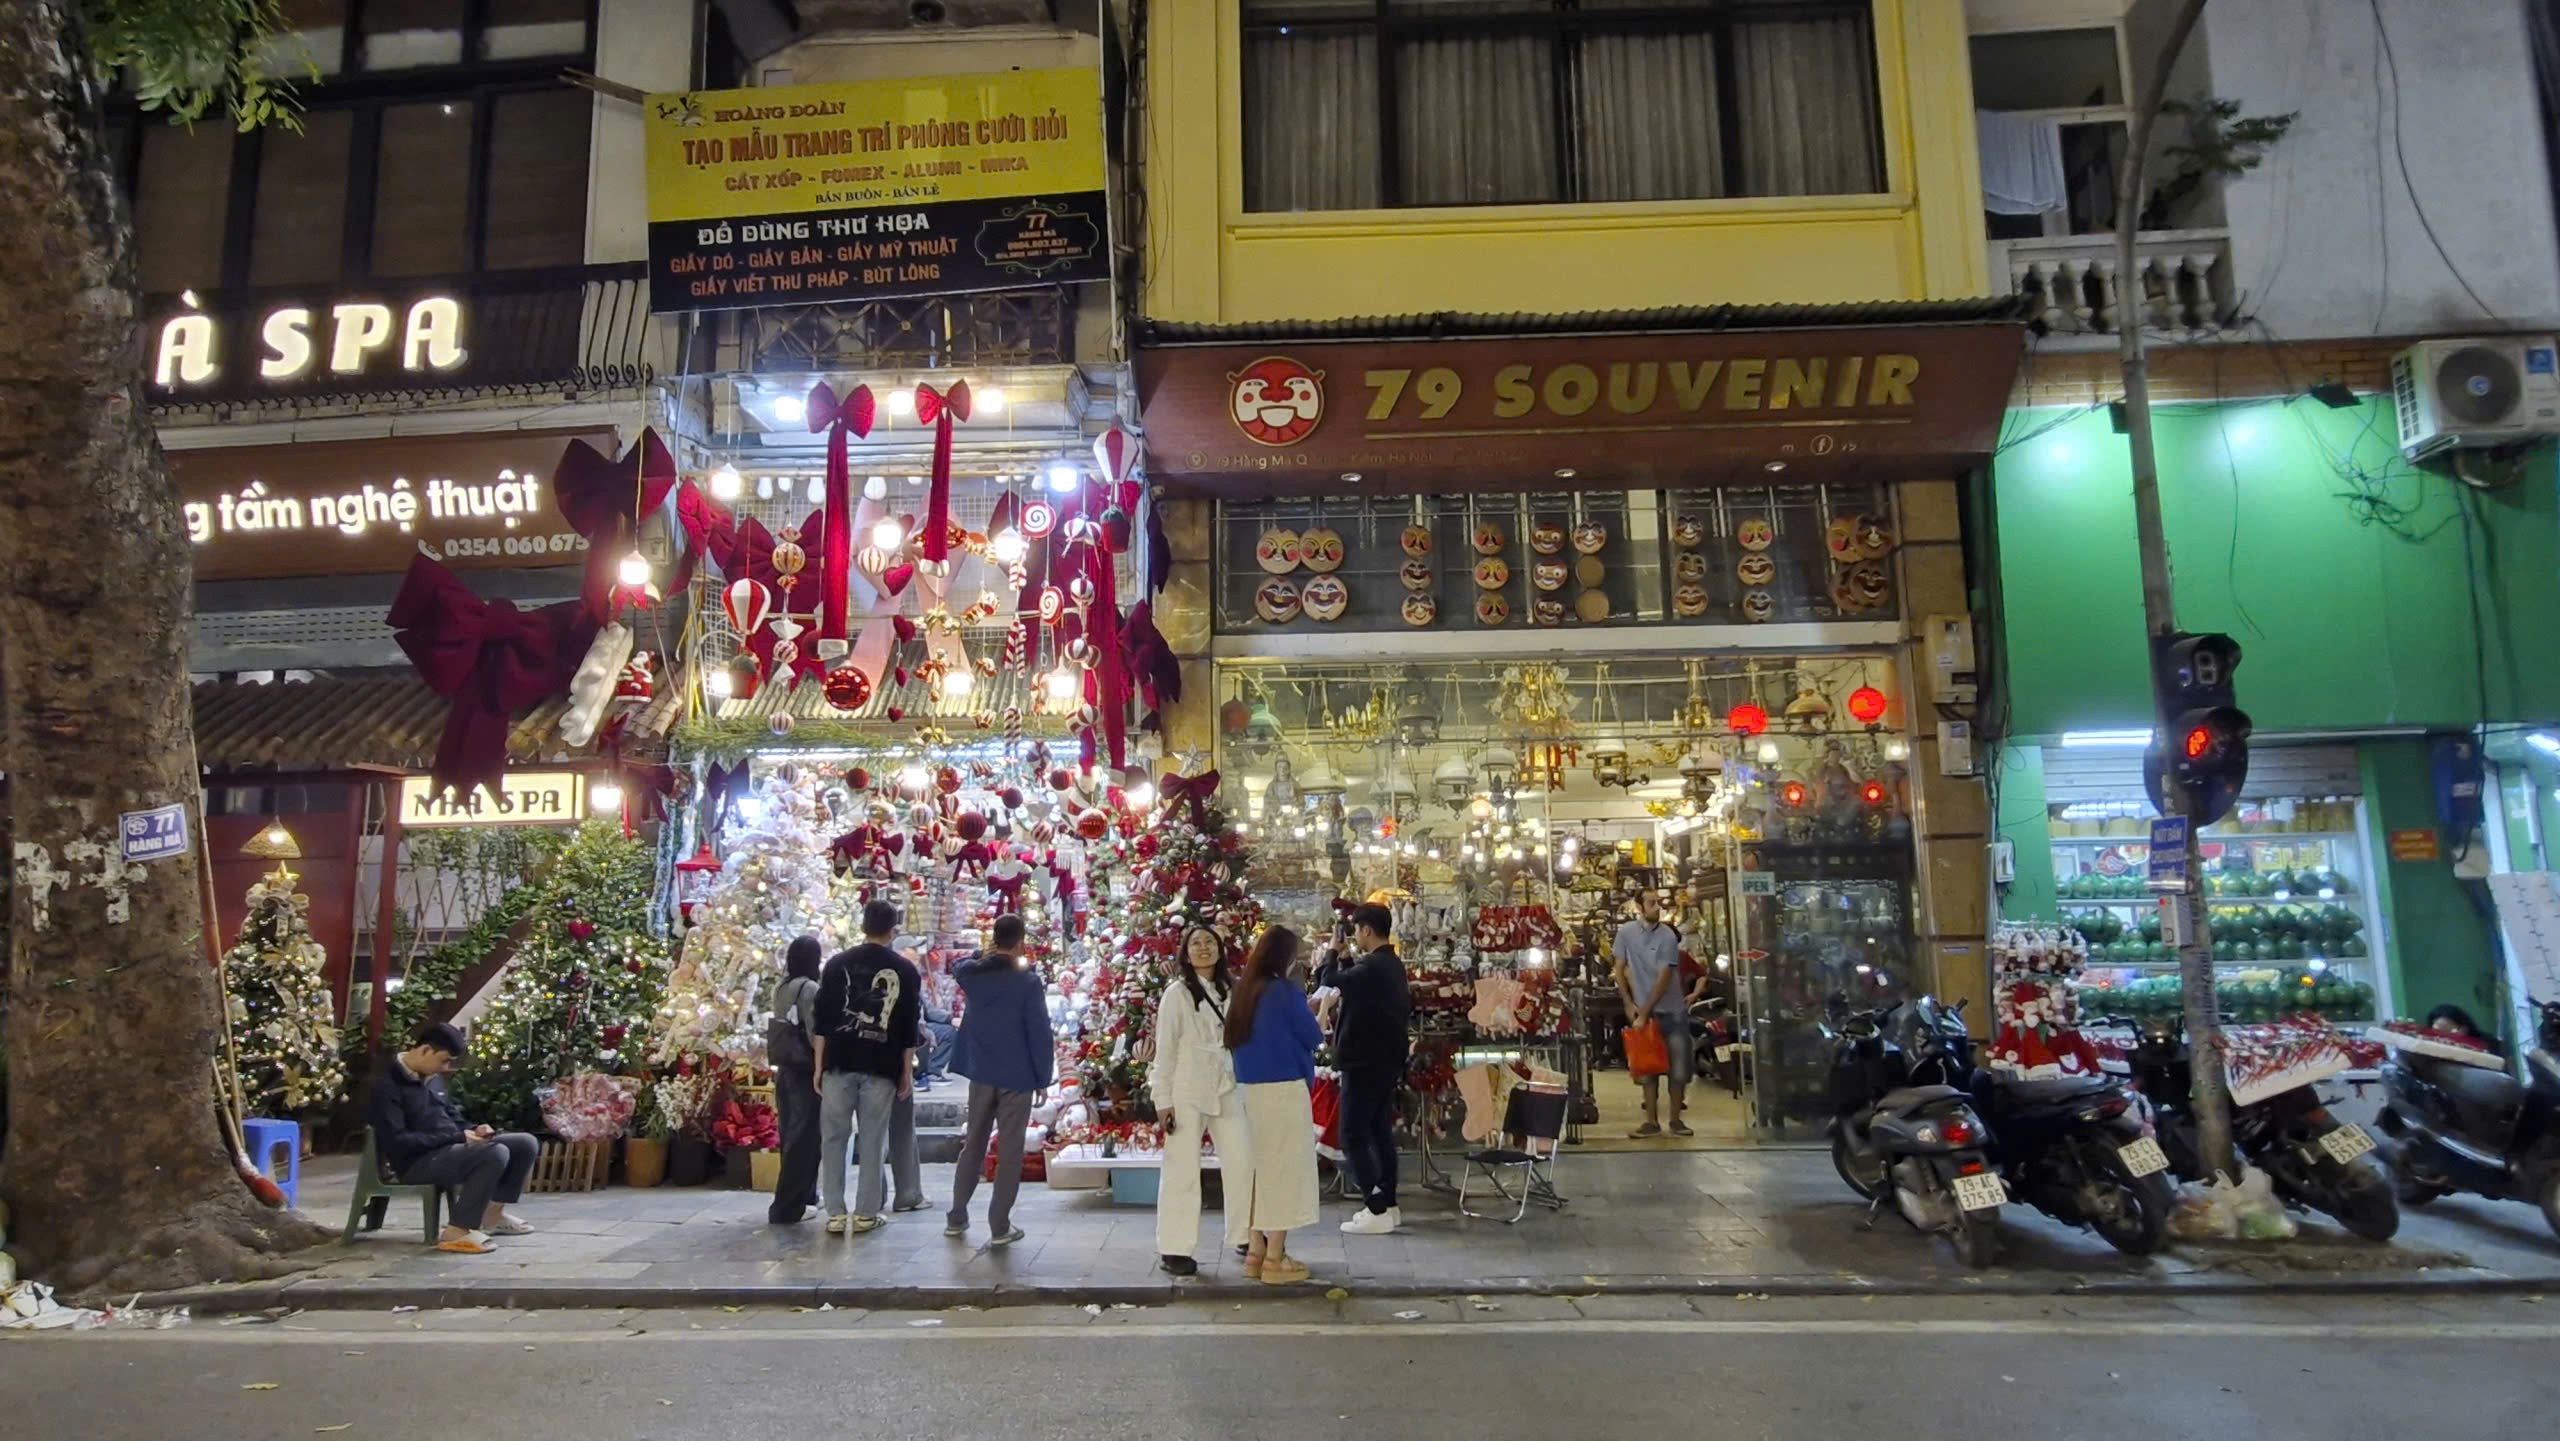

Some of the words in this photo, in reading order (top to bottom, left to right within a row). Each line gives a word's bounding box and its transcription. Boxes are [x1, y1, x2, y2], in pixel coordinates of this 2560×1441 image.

[714, 105, 786, 122] HOÀNG
[790, 102, 846, 117] ĐOÀN
[683, 138, 723, 170] TẠO
[730, 126, 778, 162] MẪU
[783, 129, 852, 158] TRANG
[857, 121, 891, 153] TRÍ
[975, 112, 1026, 145] CƯỚI
[1032, 107, 1068, 141] HỎI
[821, 165, 885, 184] FOMEX
[903, 160, 962, 179] ALUMI
[980, 156, 1030, 173] MIKA
[815, 192, 842, 204] BÁN
[845, 188, 882, 202] BUÔN
[893, 186, 920, 198] BÁN
[923, 182, 940, 196] LẺ
[697, 220, 733, 246] ĐỒ
[742, 221, 809, 243] DÙNG
[817, 214, 869, 237] THƯ
[875, 212, 930, 236] HỌA
[1026, 213, 1048, 229] 77
[908, 236, 958, 257] THUẬT
[807, 269, 849, 289] PHÁP
[260, 296, 468, 378] SPA
[1365, 366, 1462, 421] 79
[1493, 354, 1920, 419] SOUVENIR
[219, 480, 301, 531] tầm
[309, 478, 418, 535] nghệ
[426, 469, 540, 527] thuật
[444, 535, 501, 557] 0354
[504, 534, 547, 556] 060
[549, 532, 590, 554] 675
[154, 813, 175, 833] 77
[128, 837, 163, 853] HÀNG
